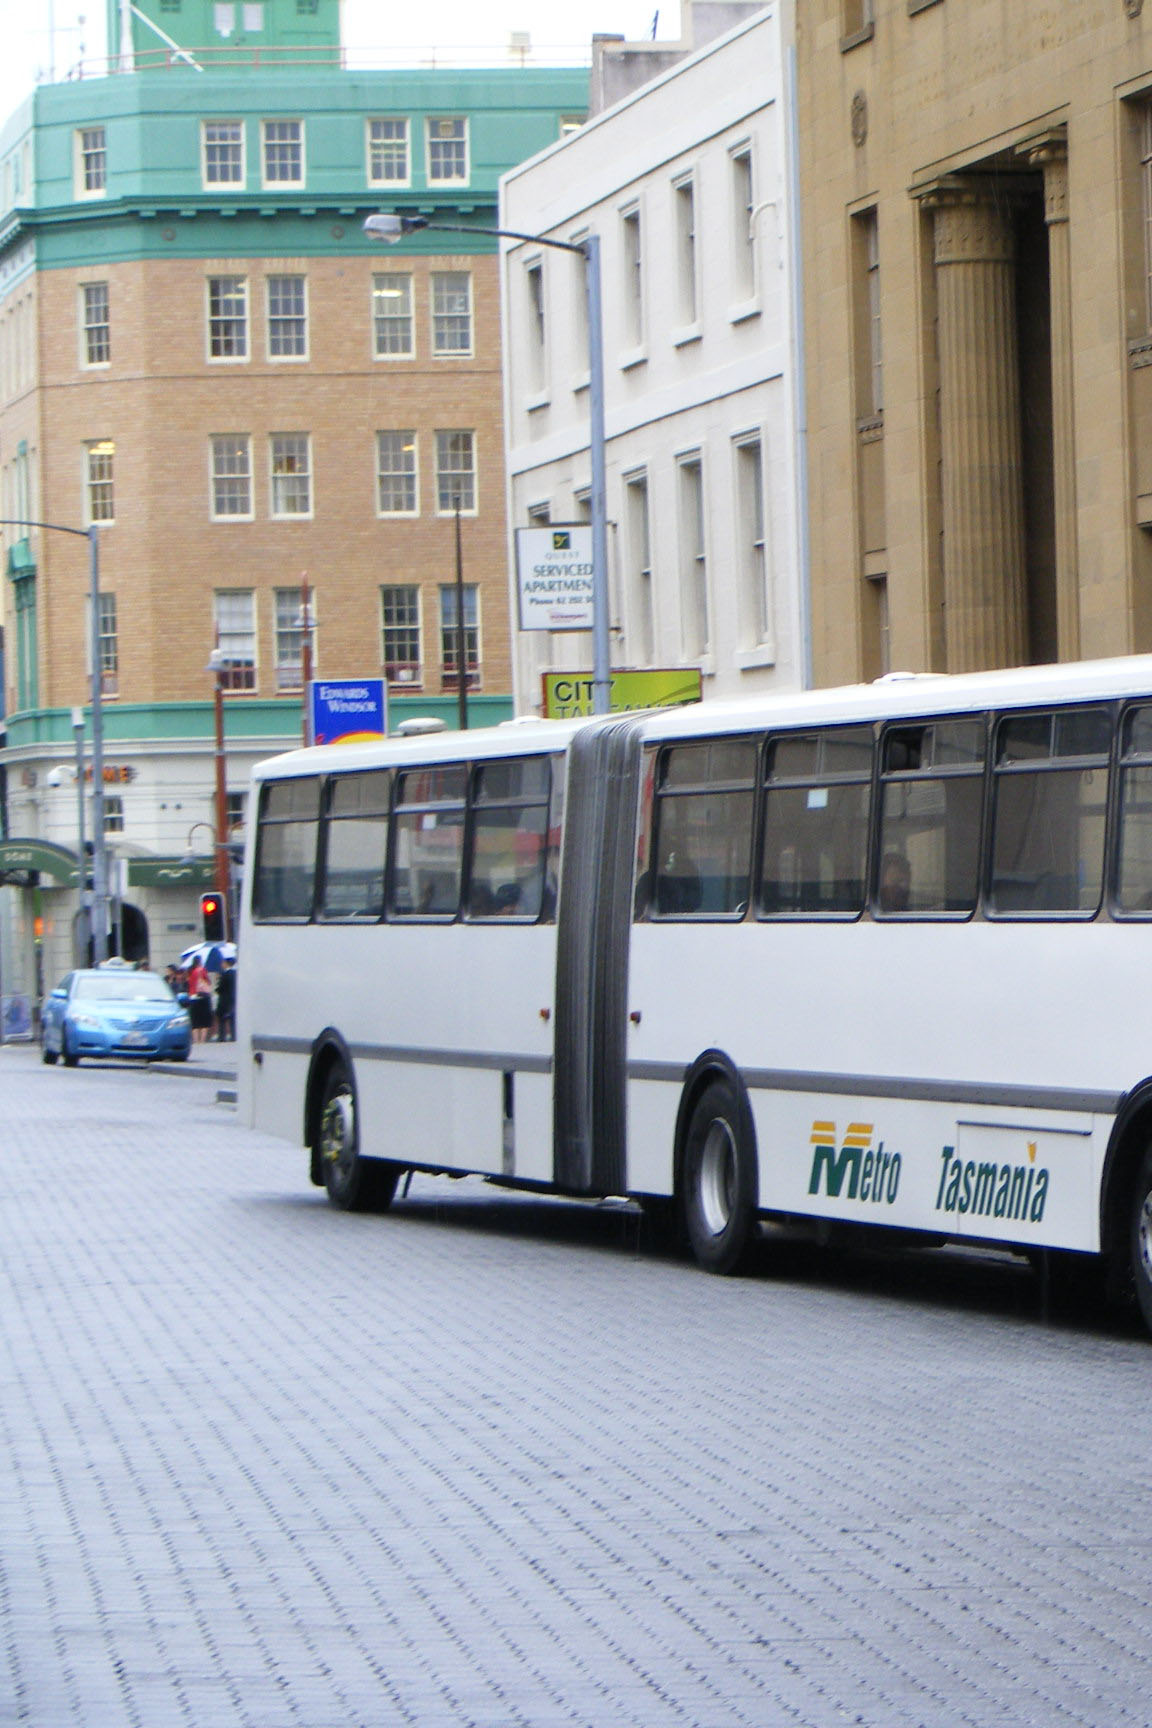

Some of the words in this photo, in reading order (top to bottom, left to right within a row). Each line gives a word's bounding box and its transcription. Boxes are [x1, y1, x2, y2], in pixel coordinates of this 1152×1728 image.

[532, 564, 595, 578] SERVICED
[523, 579, 594, 593] APARTMEN
[808, 1120, 902, 1205] Metro
[936, 1141, 1050, 1224] Tasmania
